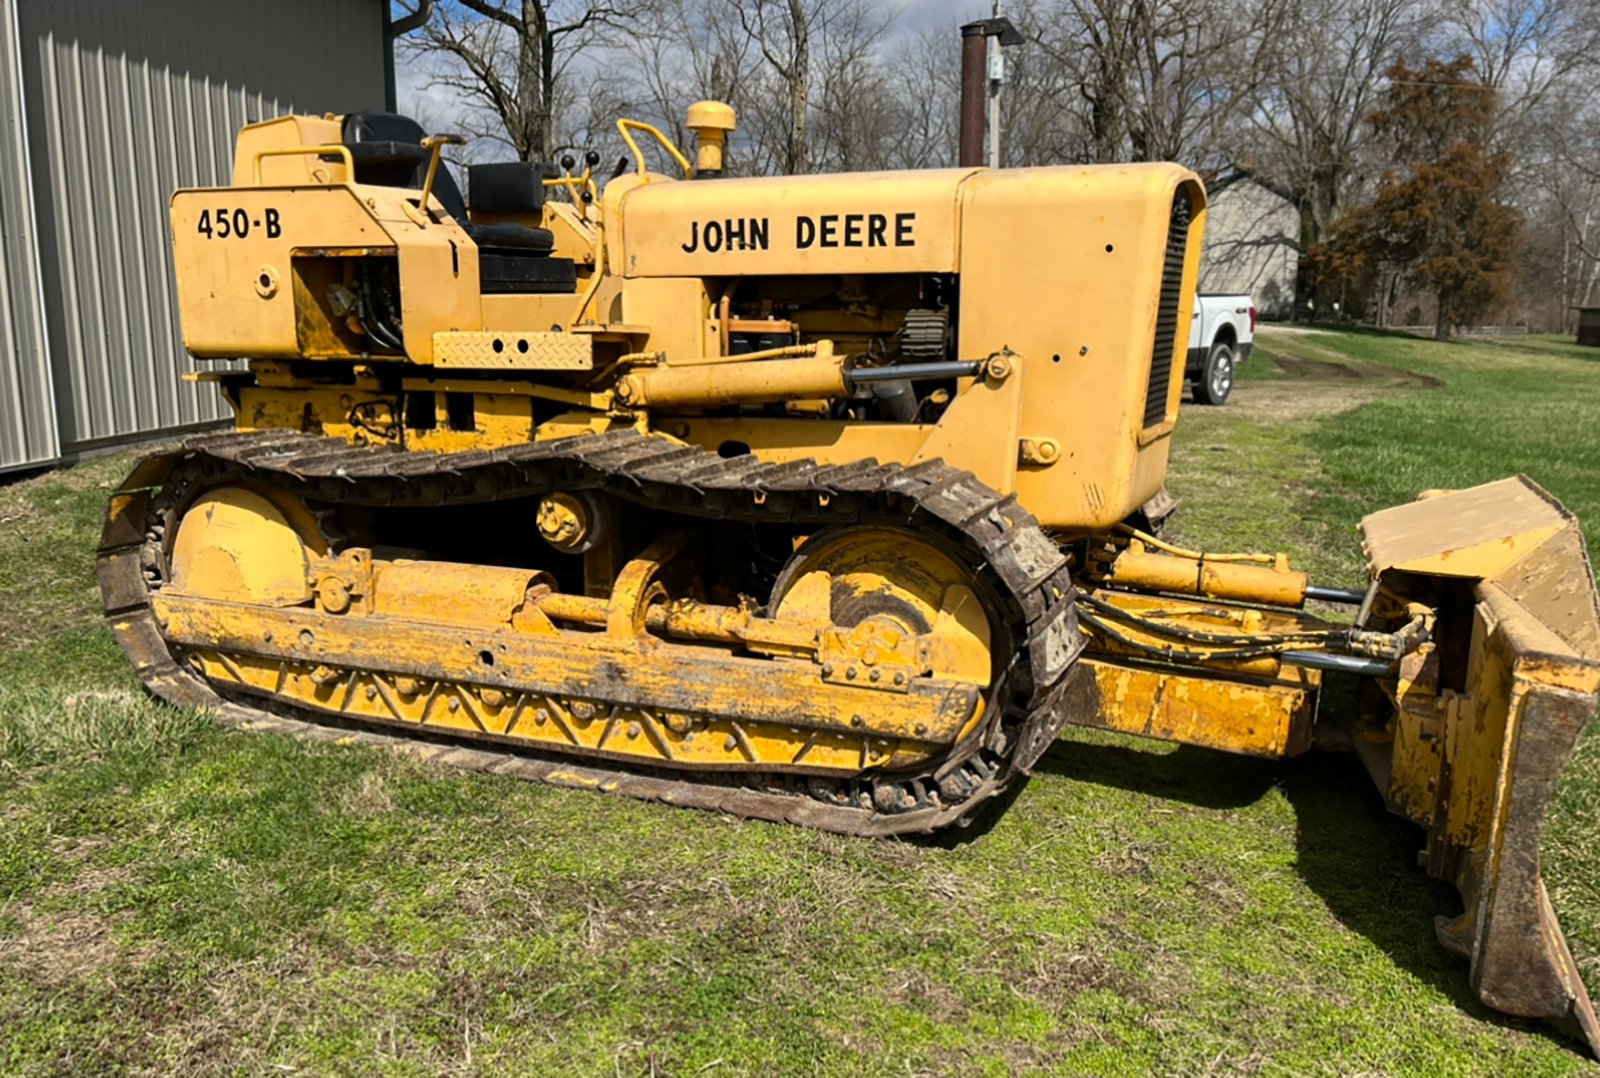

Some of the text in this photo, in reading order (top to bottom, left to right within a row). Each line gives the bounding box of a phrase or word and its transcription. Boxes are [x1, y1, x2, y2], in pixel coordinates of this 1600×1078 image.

[198, 208, 281, 239] 450-B
[681, 212, 916, 253] JOHN DEERE
